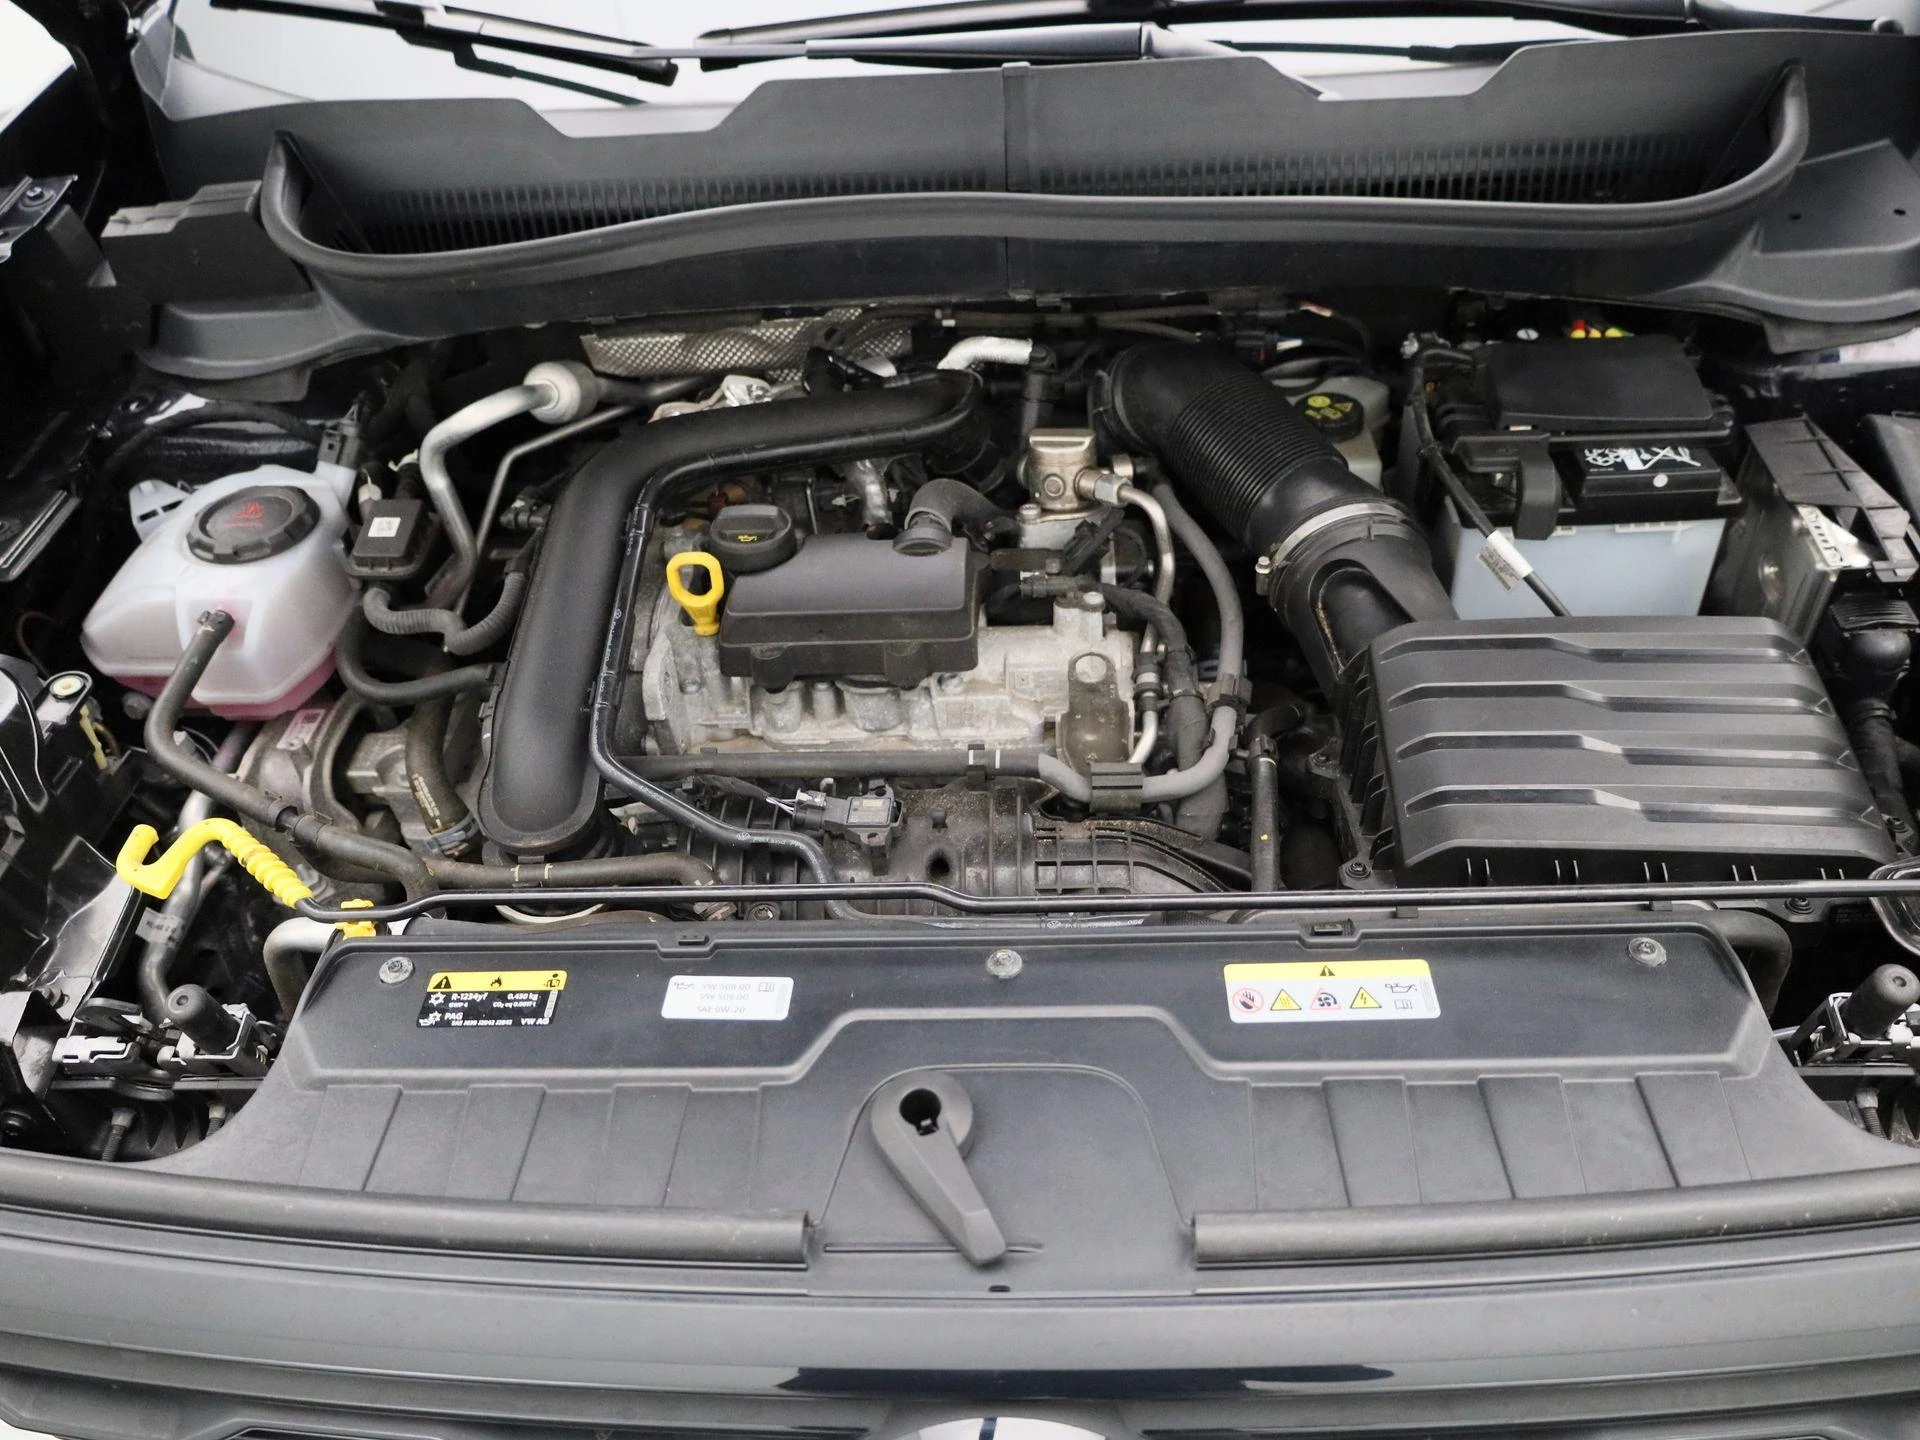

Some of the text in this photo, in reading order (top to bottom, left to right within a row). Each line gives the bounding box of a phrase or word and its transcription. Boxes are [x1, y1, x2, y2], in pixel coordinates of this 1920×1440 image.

[451, 992, 489, 1002] R-1234yf
[444, 1012, 464, 1020] PAG
[520, 1017, 550, 1025] VW AG
